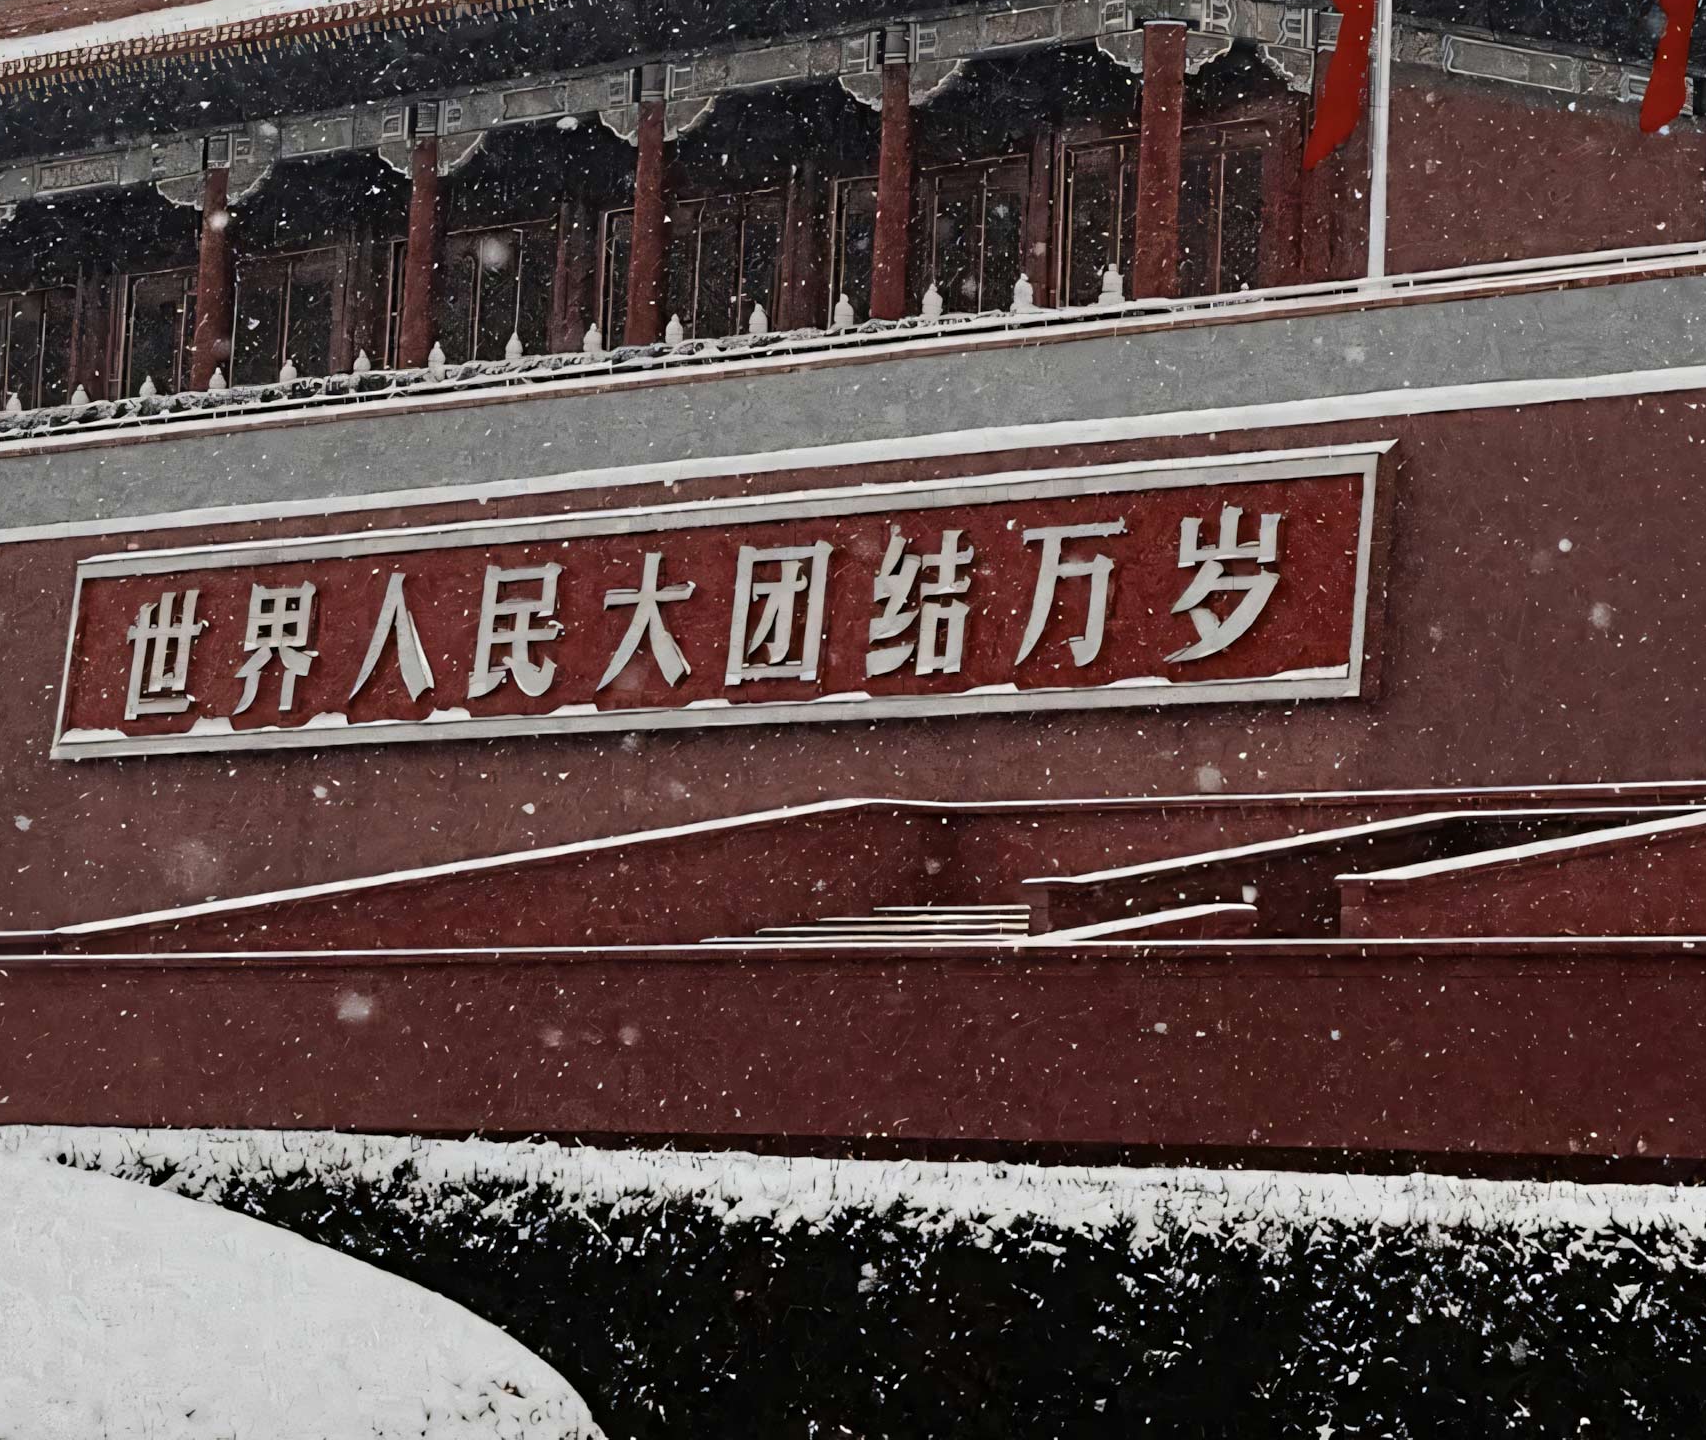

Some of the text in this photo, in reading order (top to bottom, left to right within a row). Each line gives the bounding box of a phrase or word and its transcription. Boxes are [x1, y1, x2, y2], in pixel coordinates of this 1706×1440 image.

[126, 507, 1281, 720] 世界人民大团结万岁
